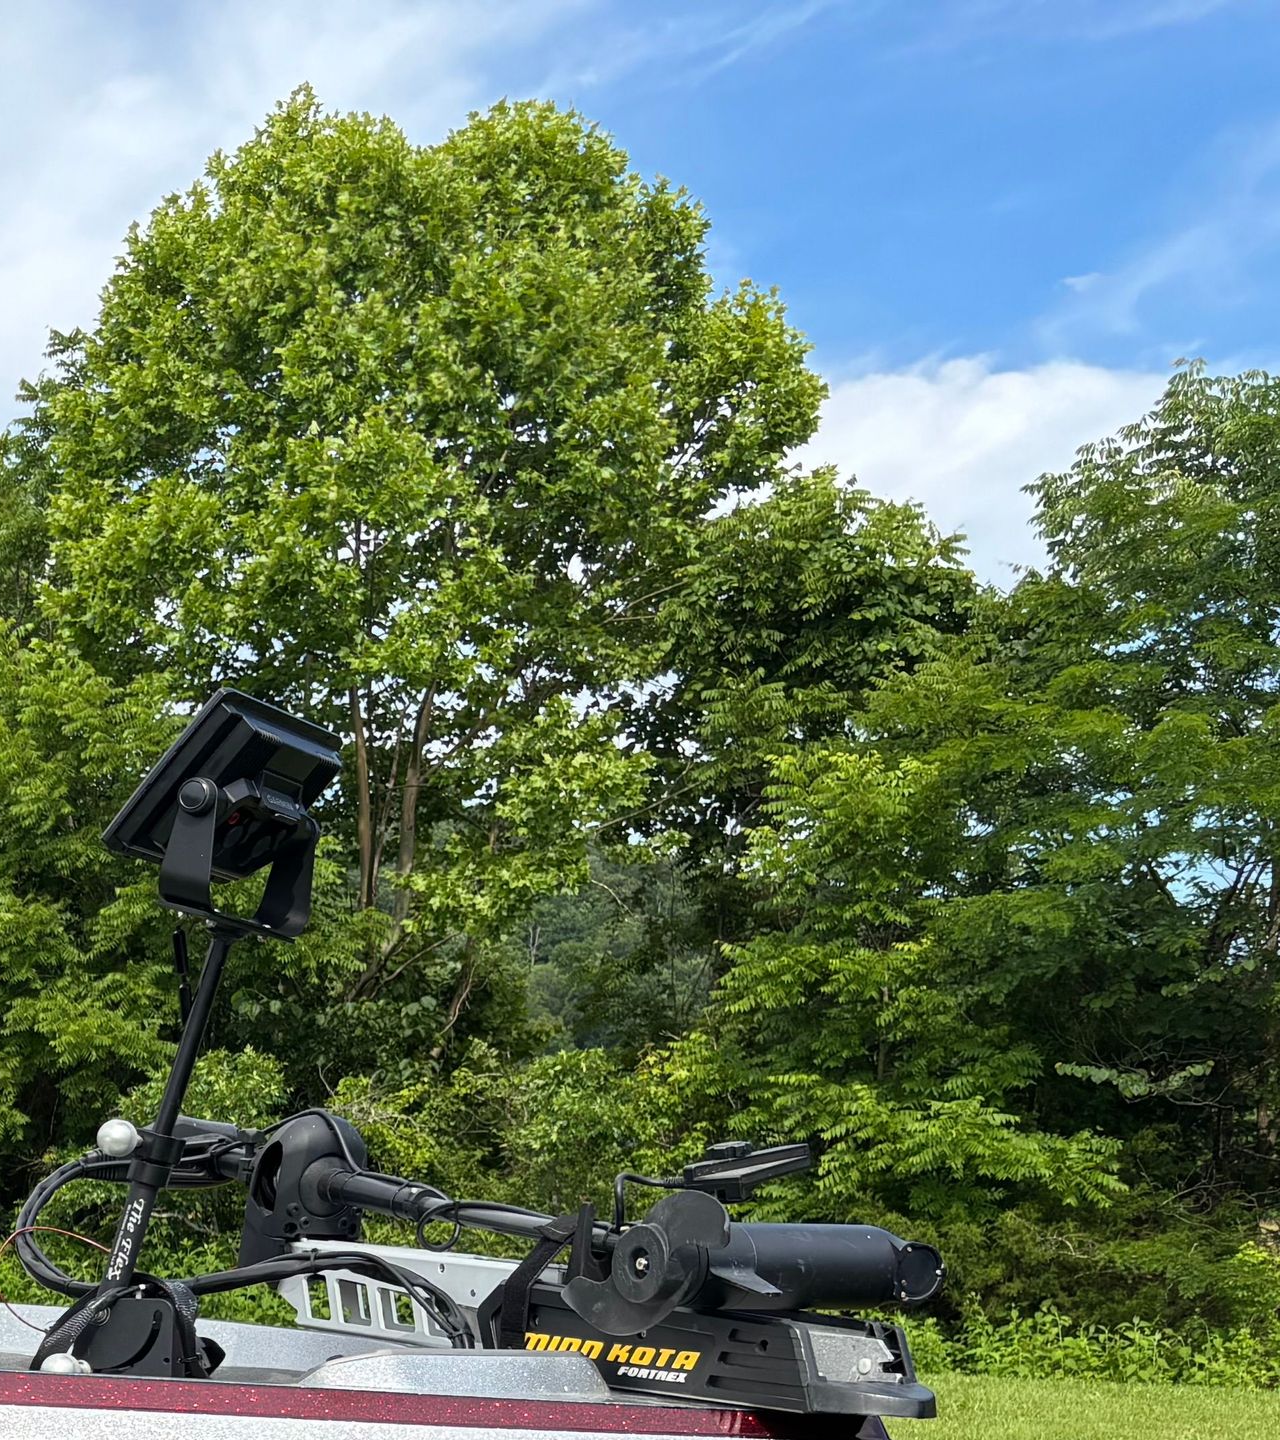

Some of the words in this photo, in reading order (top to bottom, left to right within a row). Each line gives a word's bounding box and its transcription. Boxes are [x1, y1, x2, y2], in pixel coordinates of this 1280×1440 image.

[127, 1198, 145, 1233] The
[106, 1238, 132, 1280] Flex
[606, 1343, 701, 1371] KOTA
[617, 1366, 688, 1383] FORTREX
